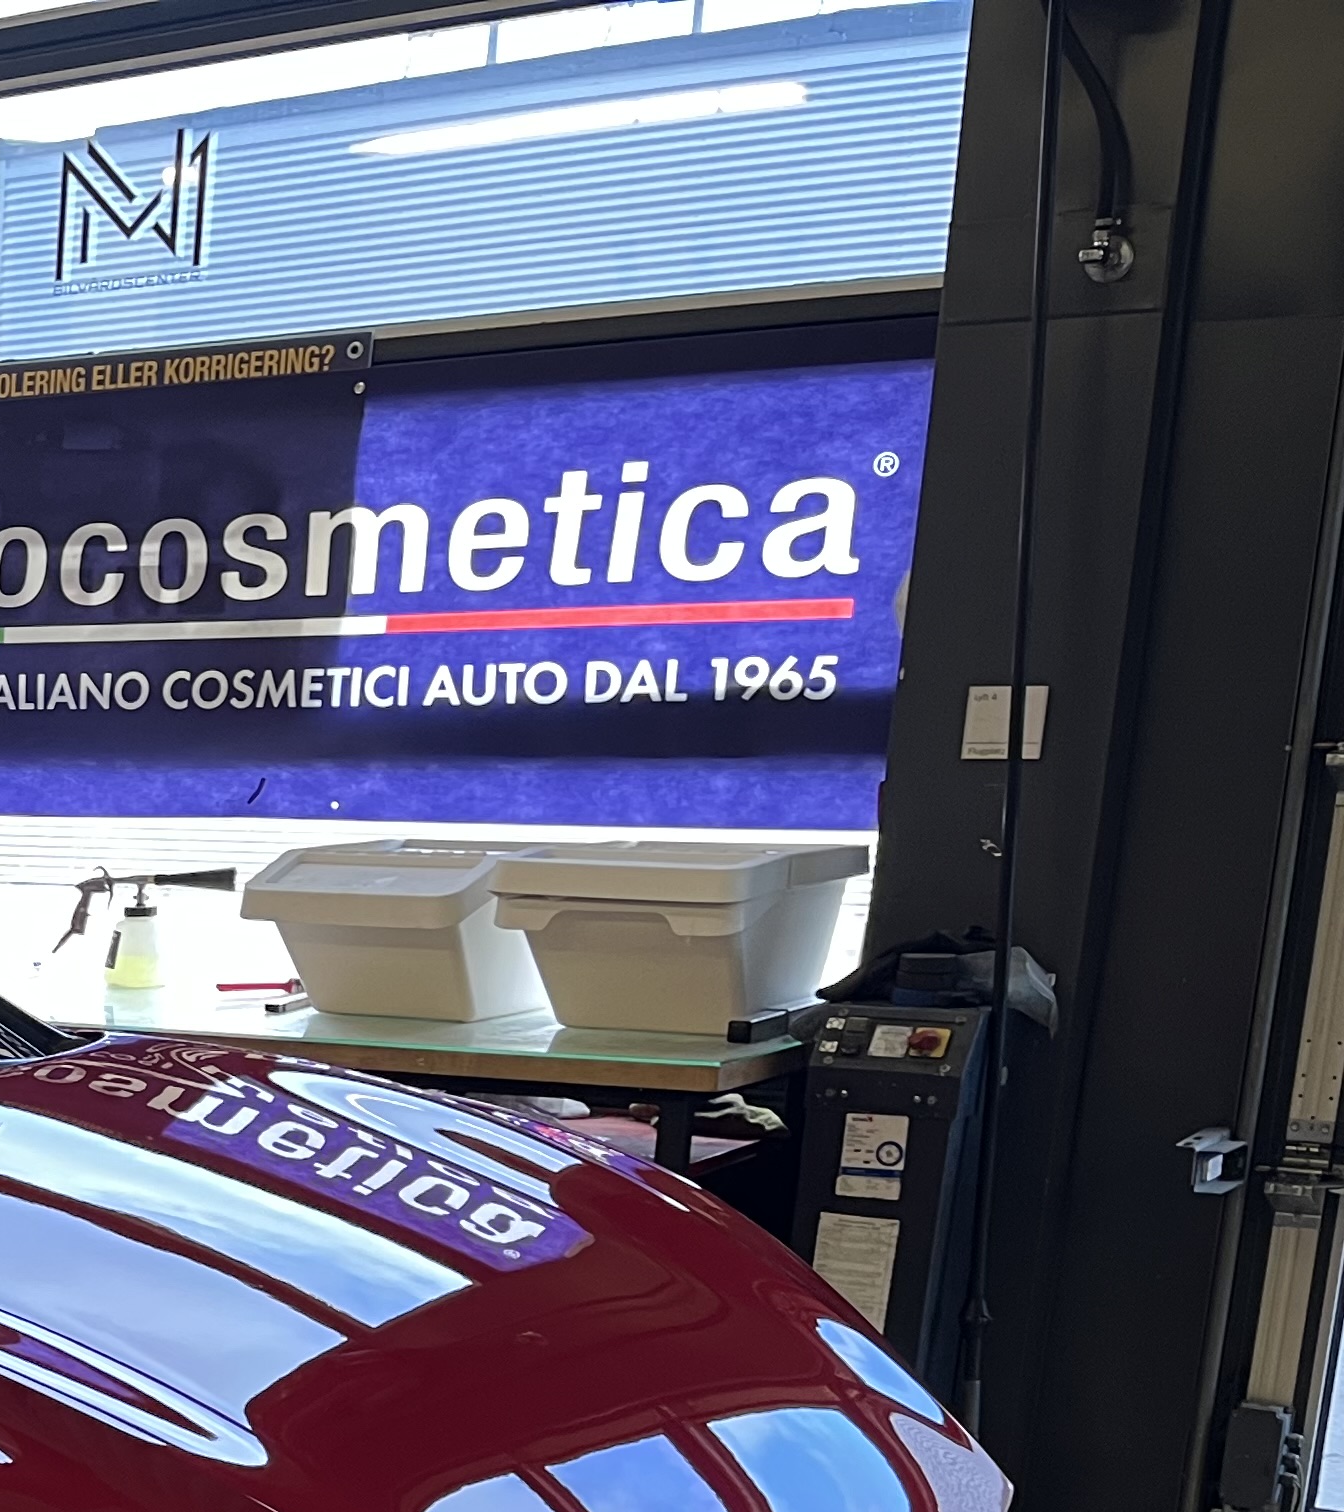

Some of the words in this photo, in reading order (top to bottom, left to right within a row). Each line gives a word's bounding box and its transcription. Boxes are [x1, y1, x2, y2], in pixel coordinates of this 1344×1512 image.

[91, 360, 159, 391] ELLER
[163, 344, 336, 386] KORRIGERING?
[162, 665, 409, 710] COSMETICI
[423, 660, 569, 708] AUTO
[585, 659, 688, 704] DAL
[711, 655, 840, 703] 1965
